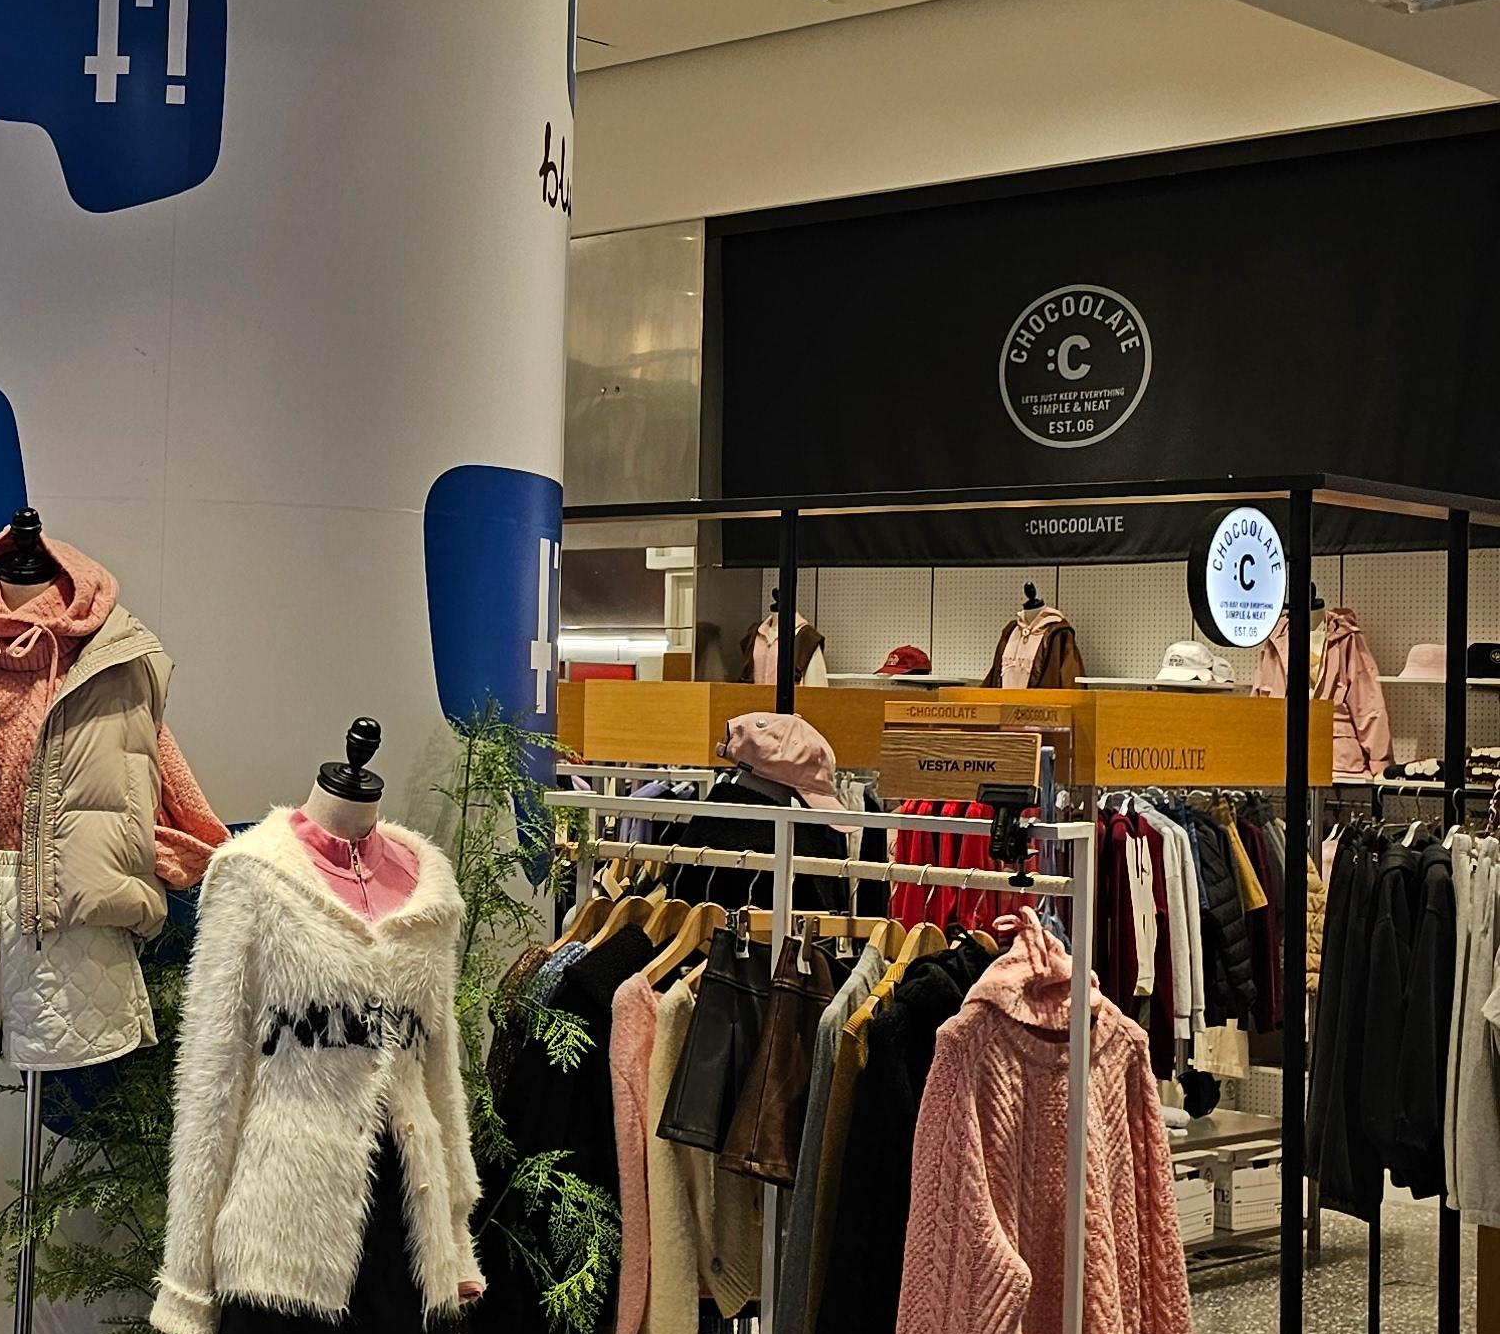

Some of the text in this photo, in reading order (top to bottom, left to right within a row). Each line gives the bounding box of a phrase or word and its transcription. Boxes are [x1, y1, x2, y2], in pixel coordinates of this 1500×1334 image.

[1009, 295, 1141, 364] CHOCOOLATE
[1040, 393, 1058, 402] JUST
[1060, 391, 1078, 400] KEEP
[1080, 387, 1125, 400] EVERYTHING
[1032, 399, 1111, 416] SIMPLE & NEAT
[1025, 516, 1125, 535] :CHOCOOLATE
[1212, 518, 1282, 574] CHOCOOLATE
[917, 759, 997, 773] VESTA PINK
[1107, 746, 1206, 771] :CHOCOOLATE
